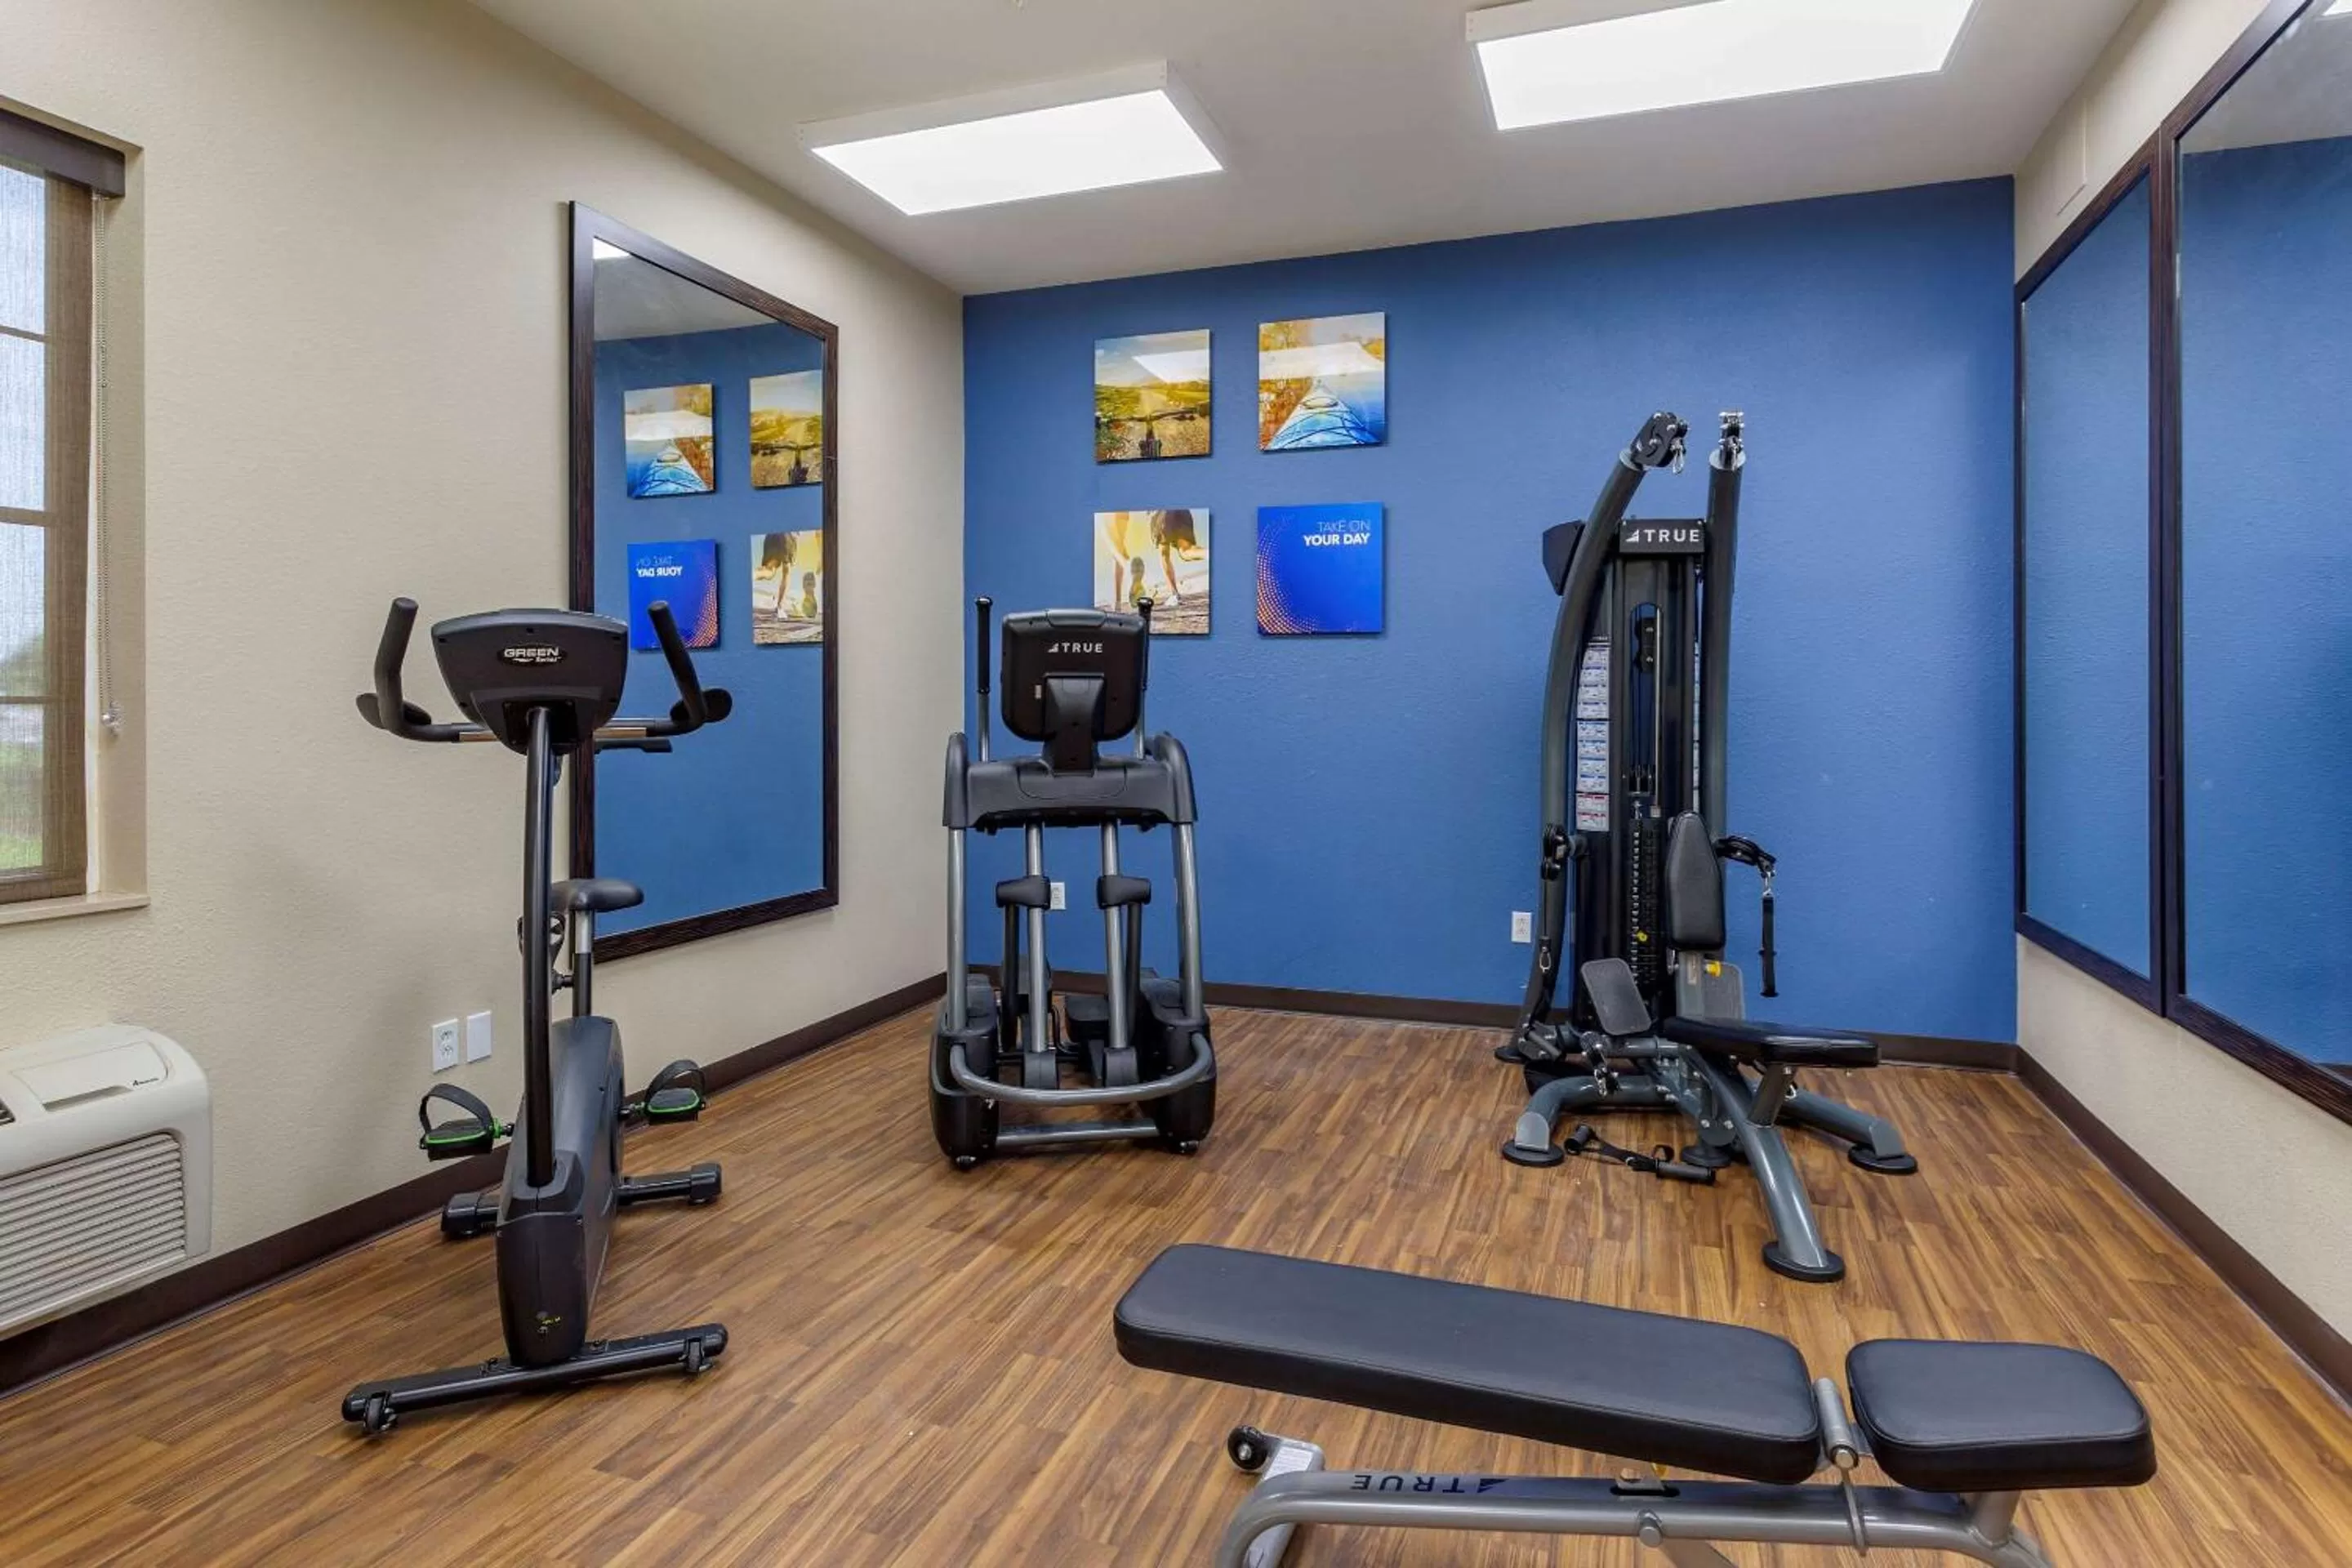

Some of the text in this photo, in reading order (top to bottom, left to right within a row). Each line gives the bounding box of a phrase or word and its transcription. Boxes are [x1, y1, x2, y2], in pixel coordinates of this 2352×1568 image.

[1316, 519, 1371, 532] TAKE ON
[1303, 532, 1370, 546] YOUR DAY
[1643, 529, 1699, 542] TRUE
[504, 647, 559, 657] GREEN
[1062, 642, 1102, 653] TRUE
[1350, 1475, 1465, 1494] TRUE
